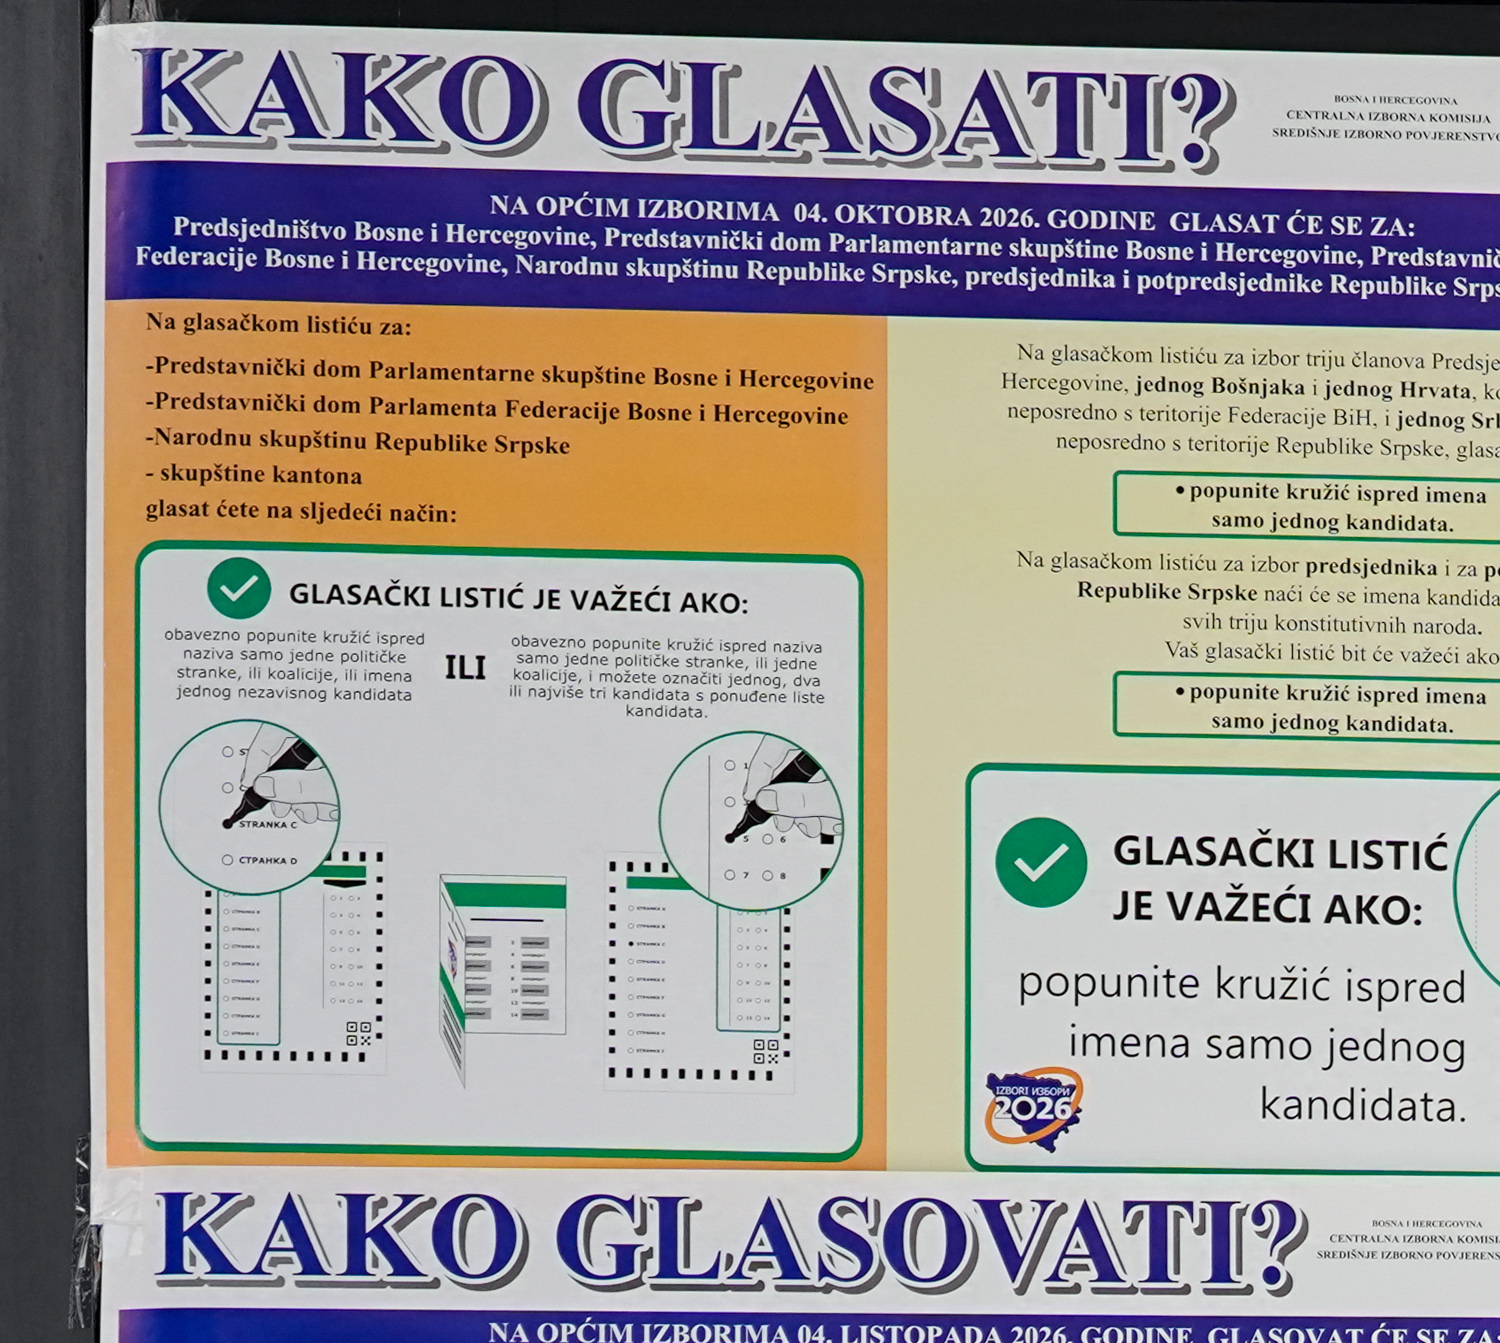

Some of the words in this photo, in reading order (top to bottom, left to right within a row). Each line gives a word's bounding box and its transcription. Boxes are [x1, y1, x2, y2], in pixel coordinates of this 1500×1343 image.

[130, 45, 545, 153] KAKO
[577, 56, 1236, 170] GLASATI?
[1334, 95, 1369, 104] BOSNA
[1373, 96, 1376, 104] I
[1380, 96, 1458, 105] HERCEGOVINA
[1286, 110, 1363, 121] CENTRALNA
[1369, 112, 1426, 122] IZBORNA
[1430, 113, 1491, 124] KOMISIJA
[1272, 126, 1340, 139] SREDIŠNJE
[1344, 129, 1401, 140] IZBORNO
[491, 195, 529, 216] NA
[537, 191, 628, 218] OPĆIM
[638, 198, 780, 222] IZBORIMA
[794, 202, 827, 223] 04.
[835, 203, 972, 226] OKTOBRA
[980, 206, 1040, 229] 2026.
[1048, 208, 1155, 230] GODINE
[1170, 211, 1279, 234] GLASAT
[1287, 209, 1323, 235] ĆE
[1331, 216, 1362, 236] SE
[1370, 217, 1414, 237] ZA:
[147, 312, 175, 330] Na
[184, 312, 298, 336] glasačkom
[308, 315, 371, 335] listiću
[380, 322, 410, 336] za:
[146, 427, 251, 447] -Narodnu
[260, 430, 366, 453] skupštinu
[376, 432, 487, 456] Republike
[495, 434, 569, 459] Srpske
[147, 499, 209, 522] glasat
[217, 499, 259, 518] ćete
[268, 505, 292, 519] na
[301, 501, 381, 524] sljedeći
[390, 504, 456, 523] način:
[290, 579, 430, 607] GLASAČKI
[441, 582, 523, 610] LISTIĆ
[533, 589, 560, 610] JE
[571, 584, 670, 613] VAŽEĆI
[680, 592, 747, 614] AKO:
[165, 628, 240, 641] obavezno
[247, 630, 317, 645] popunite
[323, 630, 371, 644] kružić
[376, 632, 424, 647] ispred
[446, 654, 485, 680] ILI
[240, 856, 287, 864] СТРАНКА
[1114, 828, 1314, 868] GLASAČKI
[1329, 832, 1449, 872] LISTIĆ
[1113, 891, 1152, 921] JE
[1167, 883, 1310, 924] VAŽEĆI
[1324, 894, 1421, 926] AKO:
[1021, 965, 1199, 1007] popunite
[1217, 964, 1329, 1002] kružić
[1347, 968, 1464, 1012] ispred
[1071, 1022, 1189, 1059] imena
[1207, 1035, 1311, 1061] samo
[1322, 1027, 1464, 1072] jednog
[996, 1087, 1028, 1095] IZBORI
[1032, 1088, 1070, 1096] ИЗБОРИ
[1262, 1085, 1465, 1123] kandidata.
[994, 1096, 1072, 1120] 2026
[153, 1191, 525, 1288] KAKO
[556, 1194, 1305, 1294] GLASOVATI?
[489, 1322, 529, 1343] NA
[537, 1317, 633, 1343] OPĆIM
